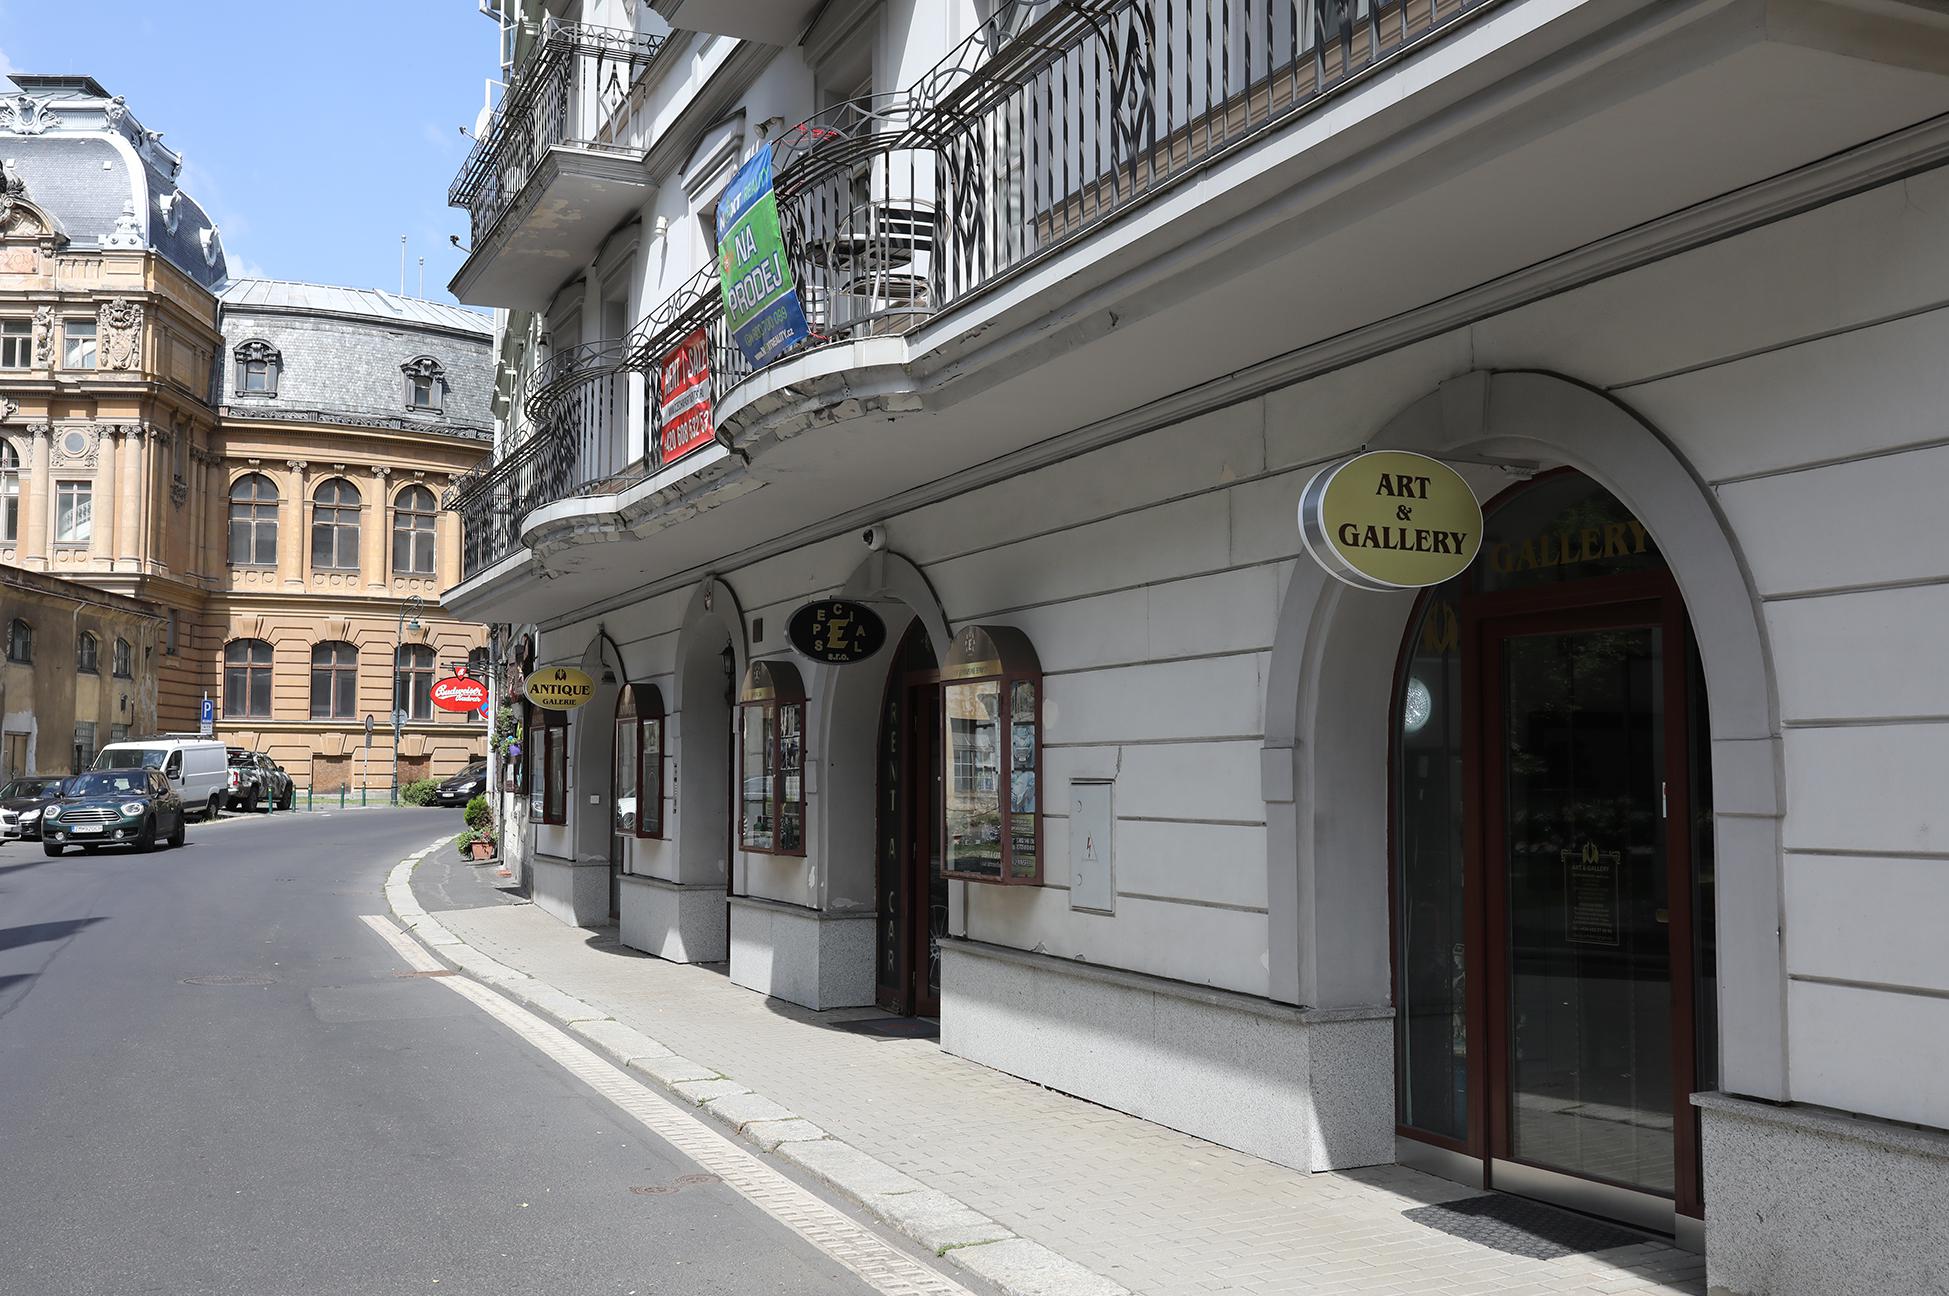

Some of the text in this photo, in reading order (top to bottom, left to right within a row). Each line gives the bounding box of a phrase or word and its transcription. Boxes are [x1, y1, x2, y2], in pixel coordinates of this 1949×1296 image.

[734, 224, 757, 267] NA
[728, 252, 784, 320] PRODEJ
[687, 339, 707, 378] SALE
[1375, 472, 1431, 500] ART
[1395, 504, 1412, 522] &
[1338, 522, 1468, 555] GALLERY
[1488, 520, 1648, 573] GALLERY
[529, 684, 590, 697] ANTIQUE
[542, 698, 576, 706] GALERIE
[203, 701, 212, 718] P
